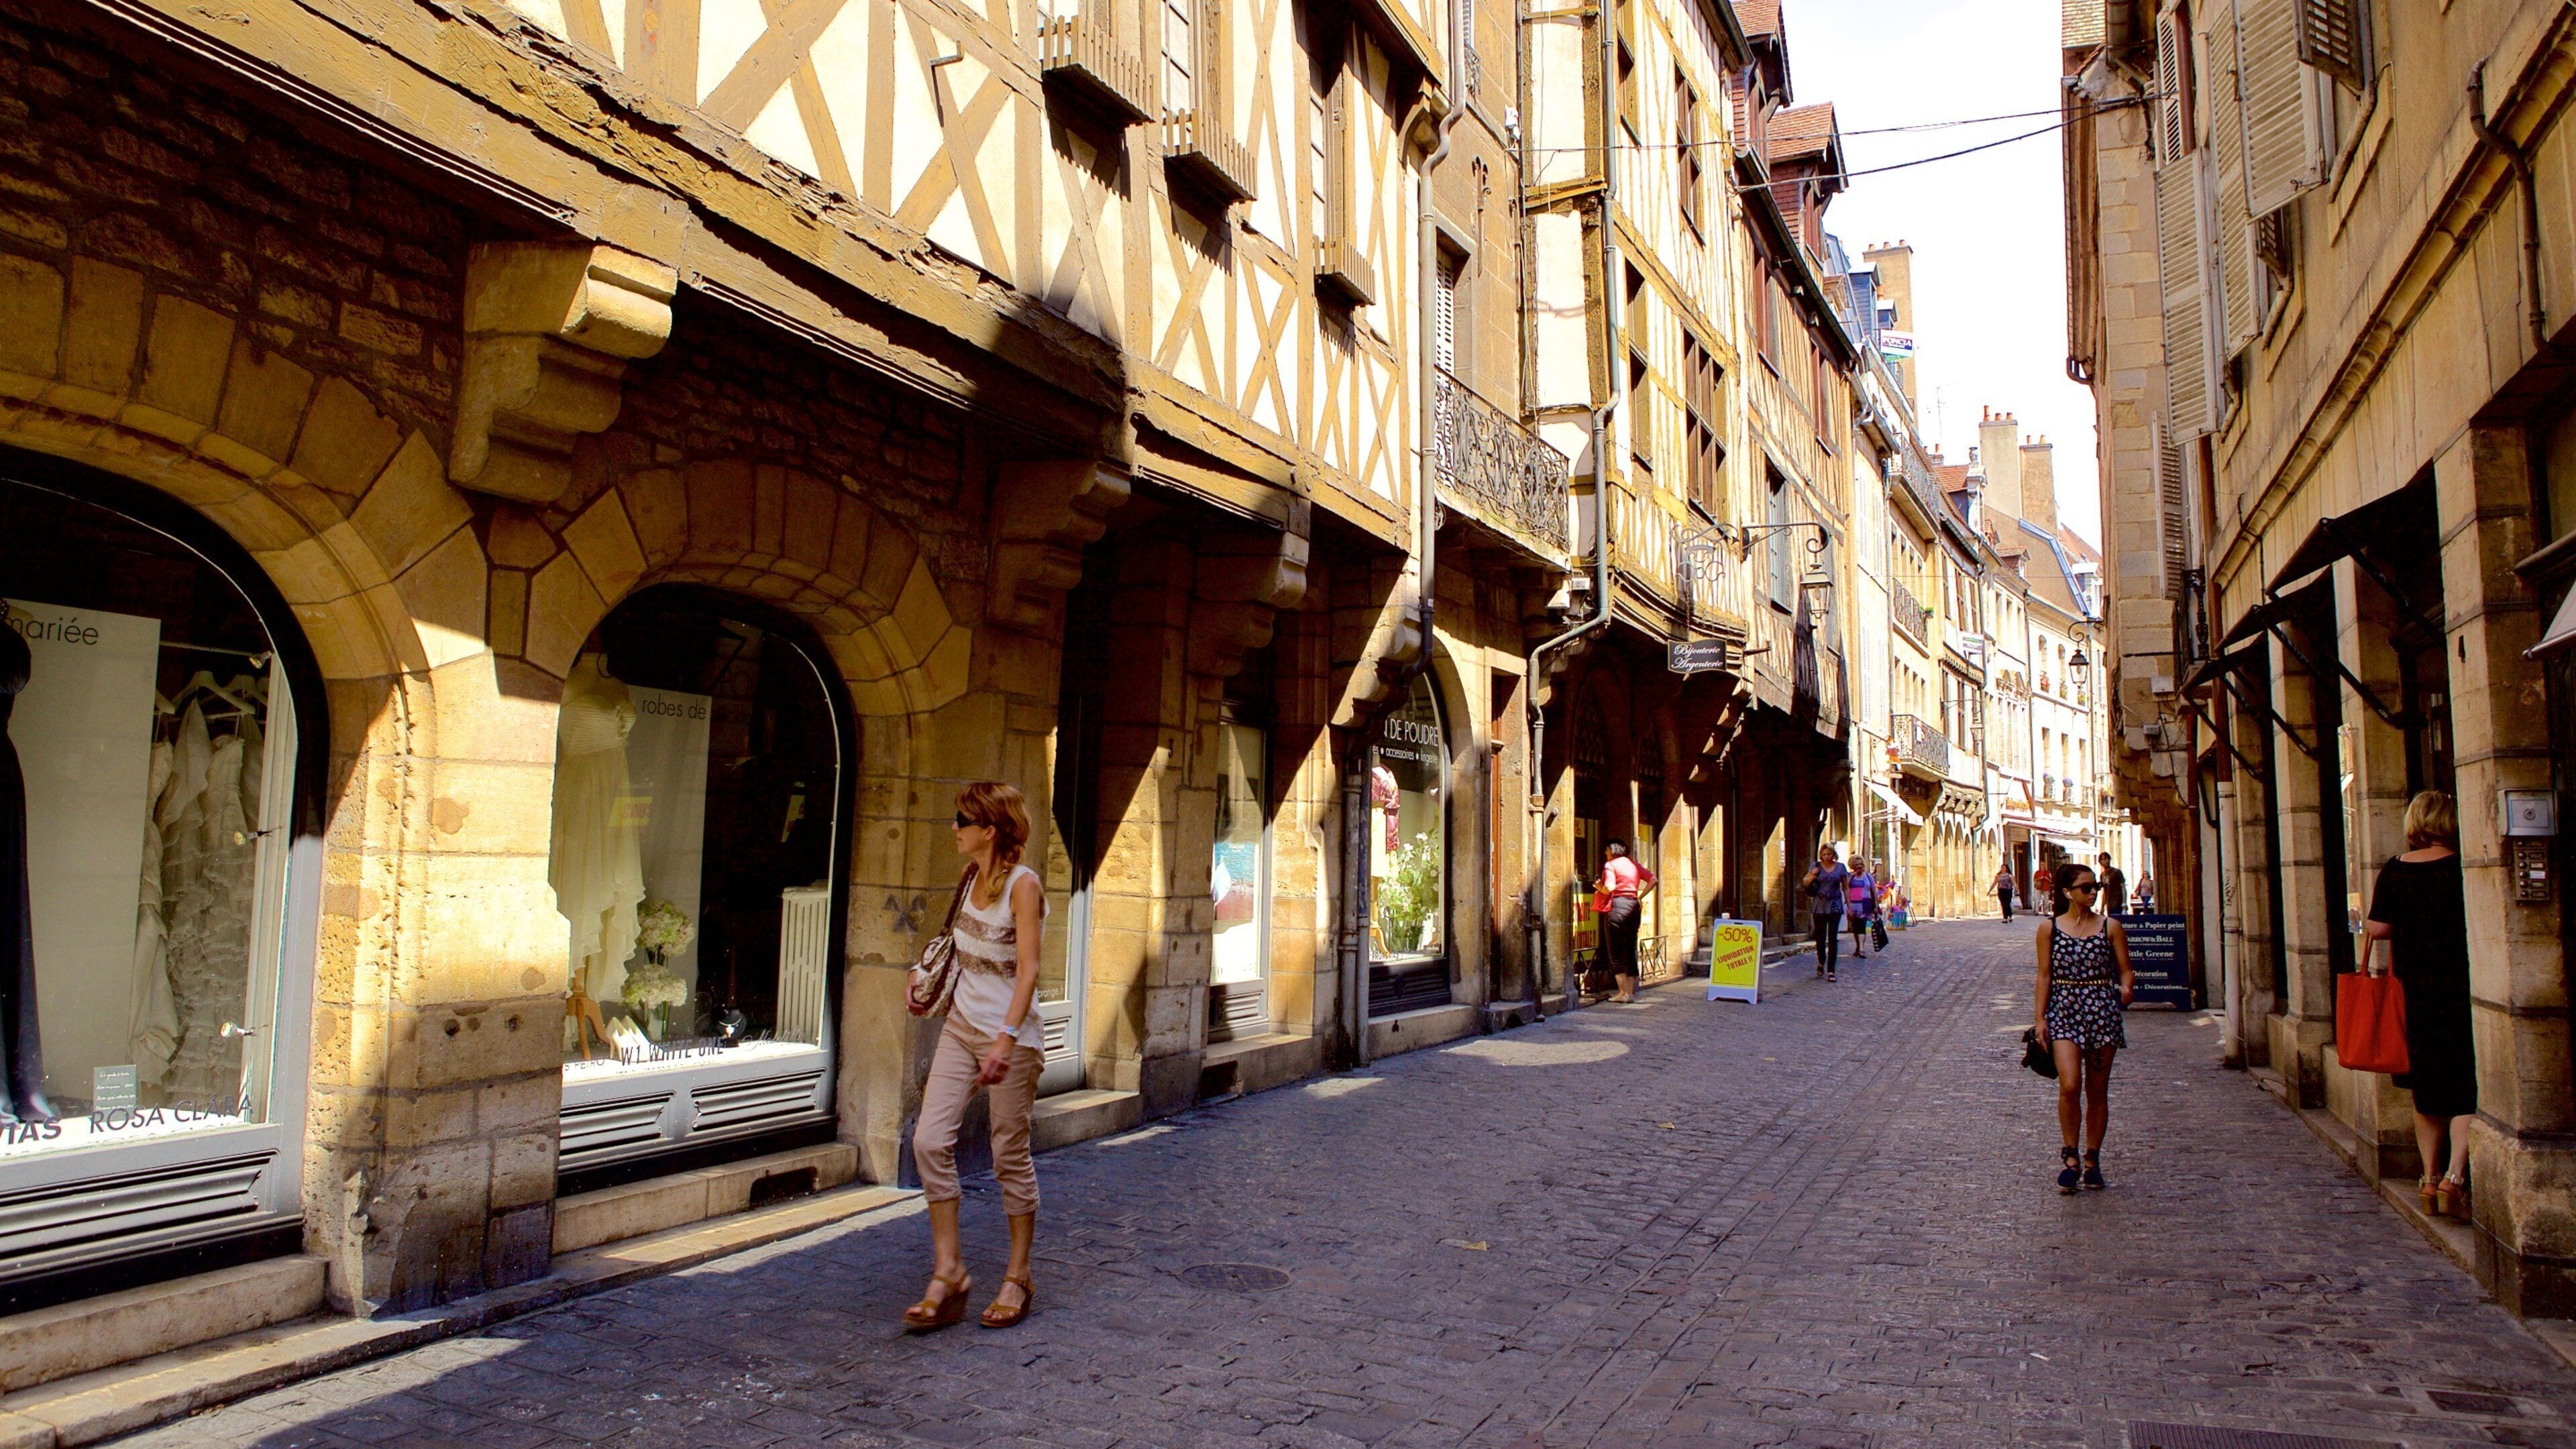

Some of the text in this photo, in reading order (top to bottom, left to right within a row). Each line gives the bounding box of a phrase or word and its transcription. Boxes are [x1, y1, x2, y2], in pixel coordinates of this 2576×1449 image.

[1674, 644, 1720, 658] Bijouterie
[1671, 657, 1723, 671] Argenterie
[642, 693, 706, 720] robes de
[1390, 718, 1402, 741] DE
[1405, 721, 1438, 746] POUDRE
[1169, 739, 1174, 758] 3
[1385, 748, 1414, 760] accessoires
[1420, 748, 1438, 765] lingerie
[1719, 927, 1753, 943] -50%
[2145, 922, 2166, 930] Papier
[1717, 945, 1754, 964] LIQUIDATION
[1726, 958, 1748, 970] TOTALE
[621, 1045, 641, 1067] W1
[649, 1038, 692, 1062] WHITE
[698, 1036, 724, 1057] ONE
[89, 1105, 165, 1134] ROSA
